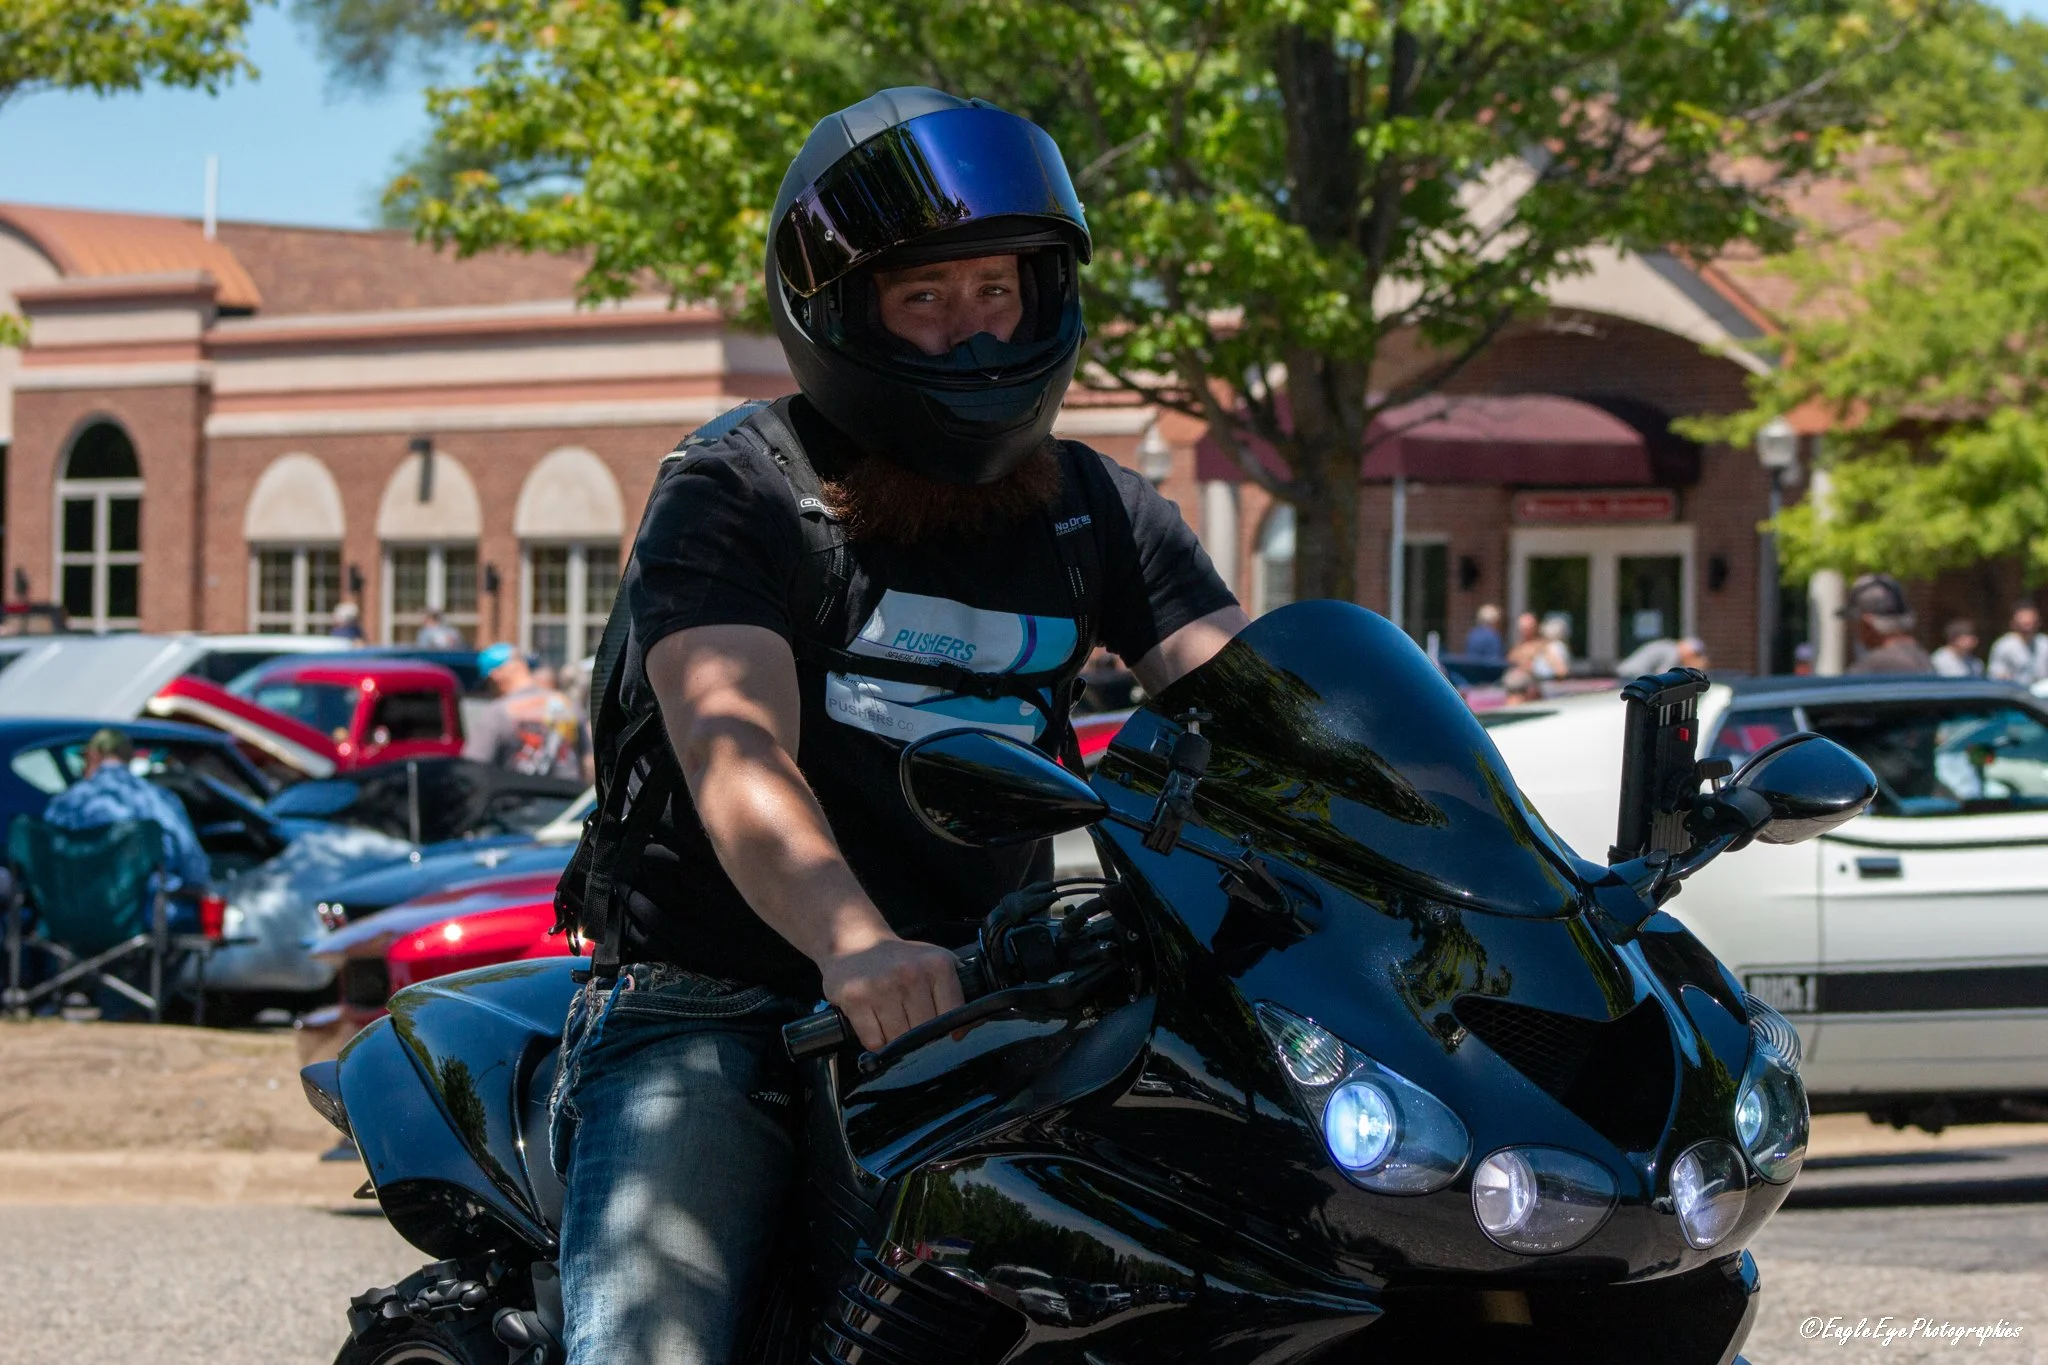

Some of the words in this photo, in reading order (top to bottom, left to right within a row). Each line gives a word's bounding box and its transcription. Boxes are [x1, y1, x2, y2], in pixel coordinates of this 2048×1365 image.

[1055, 522, 1069, 531] No
[893, 628, 977, 661] PUSHERS
[828, 697, 894, 727] PUSHERS
